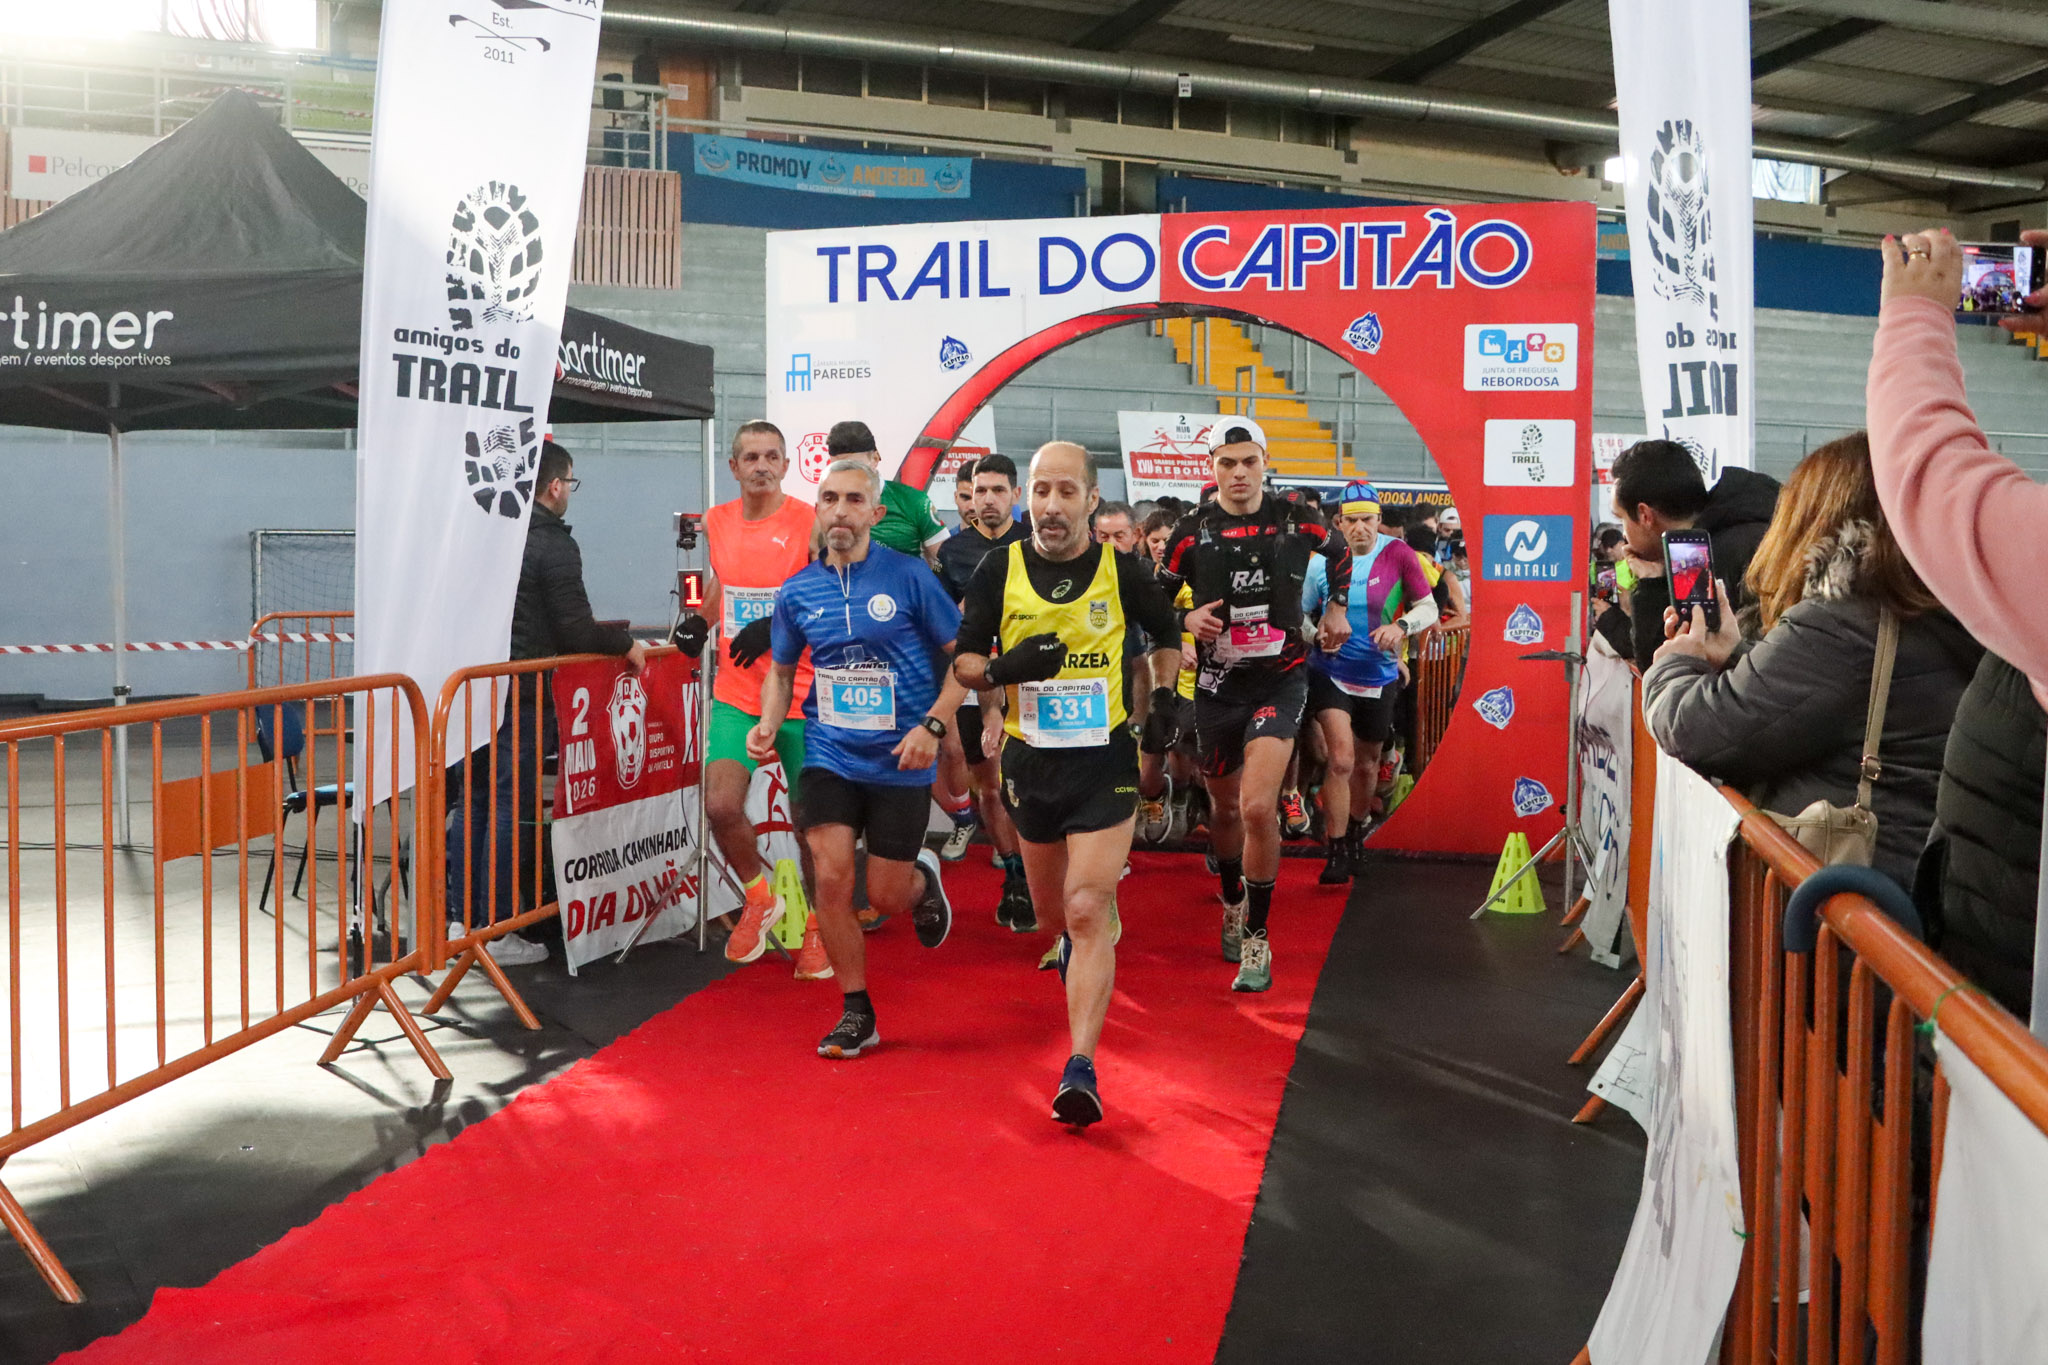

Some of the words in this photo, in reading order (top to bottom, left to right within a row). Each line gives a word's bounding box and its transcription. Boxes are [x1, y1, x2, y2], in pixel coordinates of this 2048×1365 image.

[492, 12, 513, 29] Est.
[484, 46, 515, 64] 2011
[736, 150, 811, 179] PROMOV
[852, 164, 929, 187] ANDEBOL
[817, 240, 1010, 303] TRAIL
[1039, 232, 1156, 295] DO
[1178, 208, 1533, 292] CAPITÃO
[394, 327, 484, 356] amigos
[495, 338, 521, 359] do
[34, 355, 86, 367] eventos
[90, 353, 171, 369] desportivos
[1518, 366, 1558, 374] FREGUESIA
[392, 353, 534, 414] TRAIL
[813, 368, 872, 380] PAREDES
[1481, 376, 1560, 387] REBORDOSA
[1178, 415, 1186, 425] 2
[948, 452, 982, 460] ATLETISMO
[1512, 456, 1543, 464] TRAIL
[1494, 563, 1558, 577] NORTALU
[685, 575, 702, 605] 1
[741, 602, 775, 619] 298
[841, 687, 882, 707] 405
[572, 687, 590, 736] 2
[1048, 697, 1093, 720] 331
[565, 738, 596, 776] MAIO
[564, 848, 622, 883] CORRIDA
[625, 826, 688, 866] CAMINHADA
[567, 890, 617, 941] DIA
